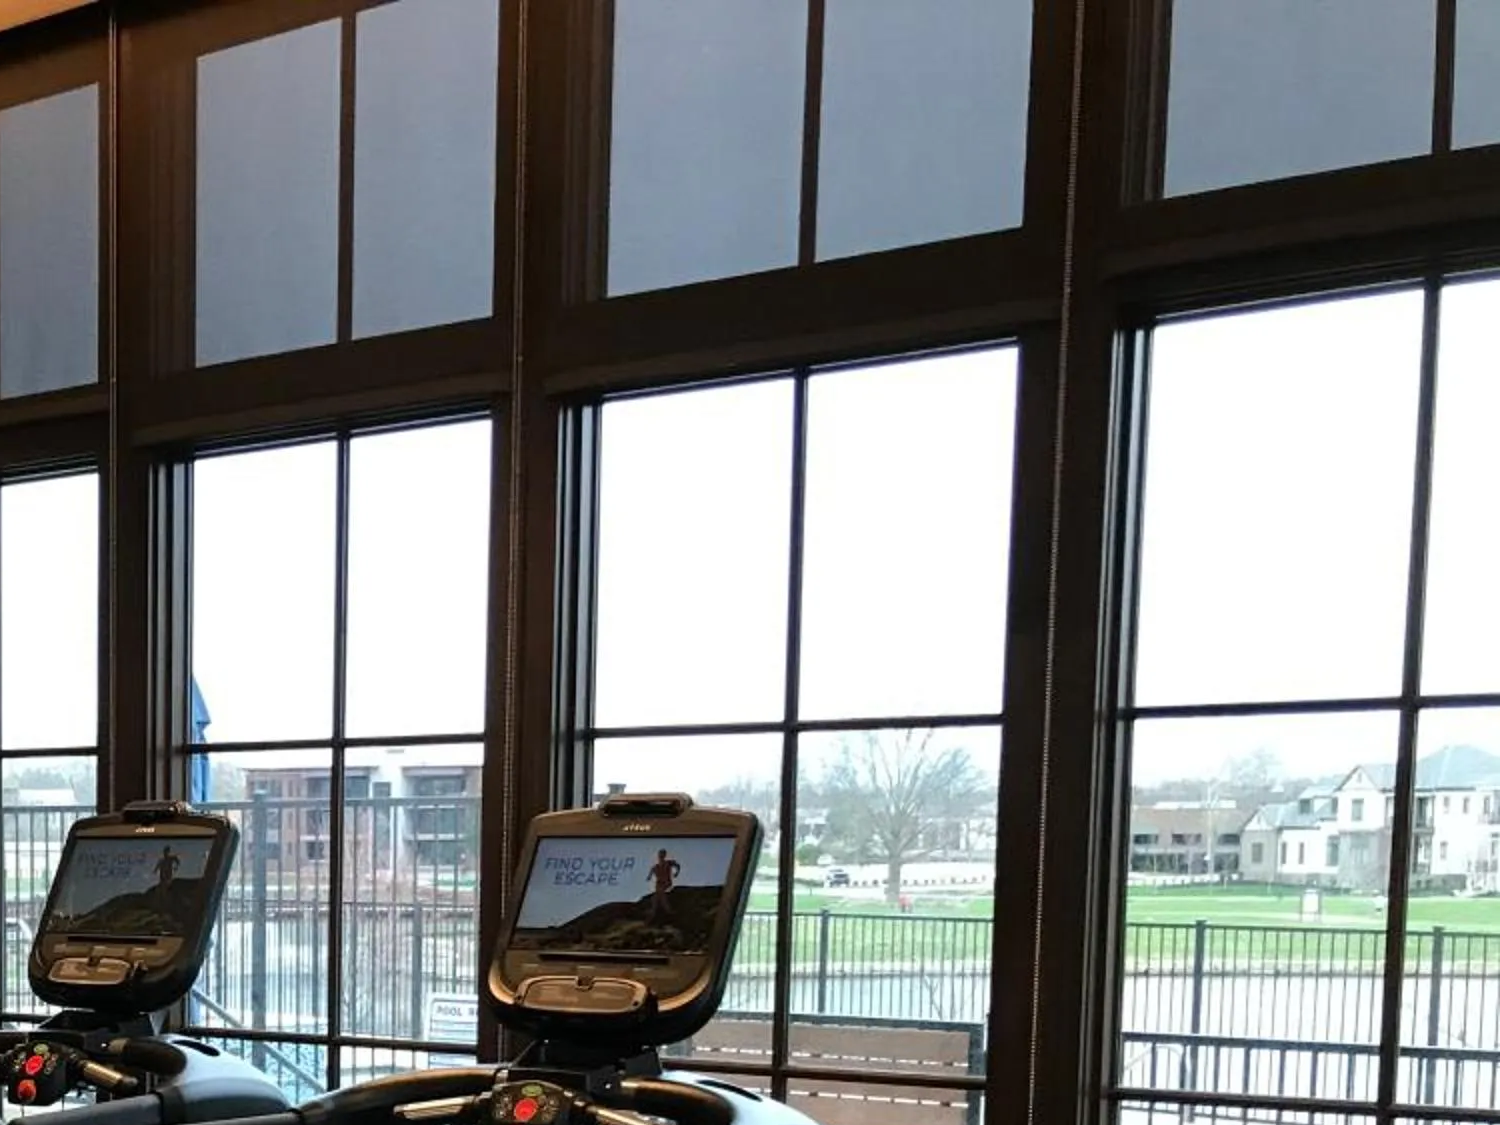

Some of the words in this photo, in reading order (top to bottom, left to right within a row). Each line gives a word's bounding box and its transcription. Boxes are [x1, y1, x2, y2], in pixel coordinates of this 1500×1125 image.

[544, 856, 584, 871] FIND
[590, 856, 636, 871] YOUR
[552, 871, 620, 886] ESCAPE
[436, 1005, 463, 1017] POOL
